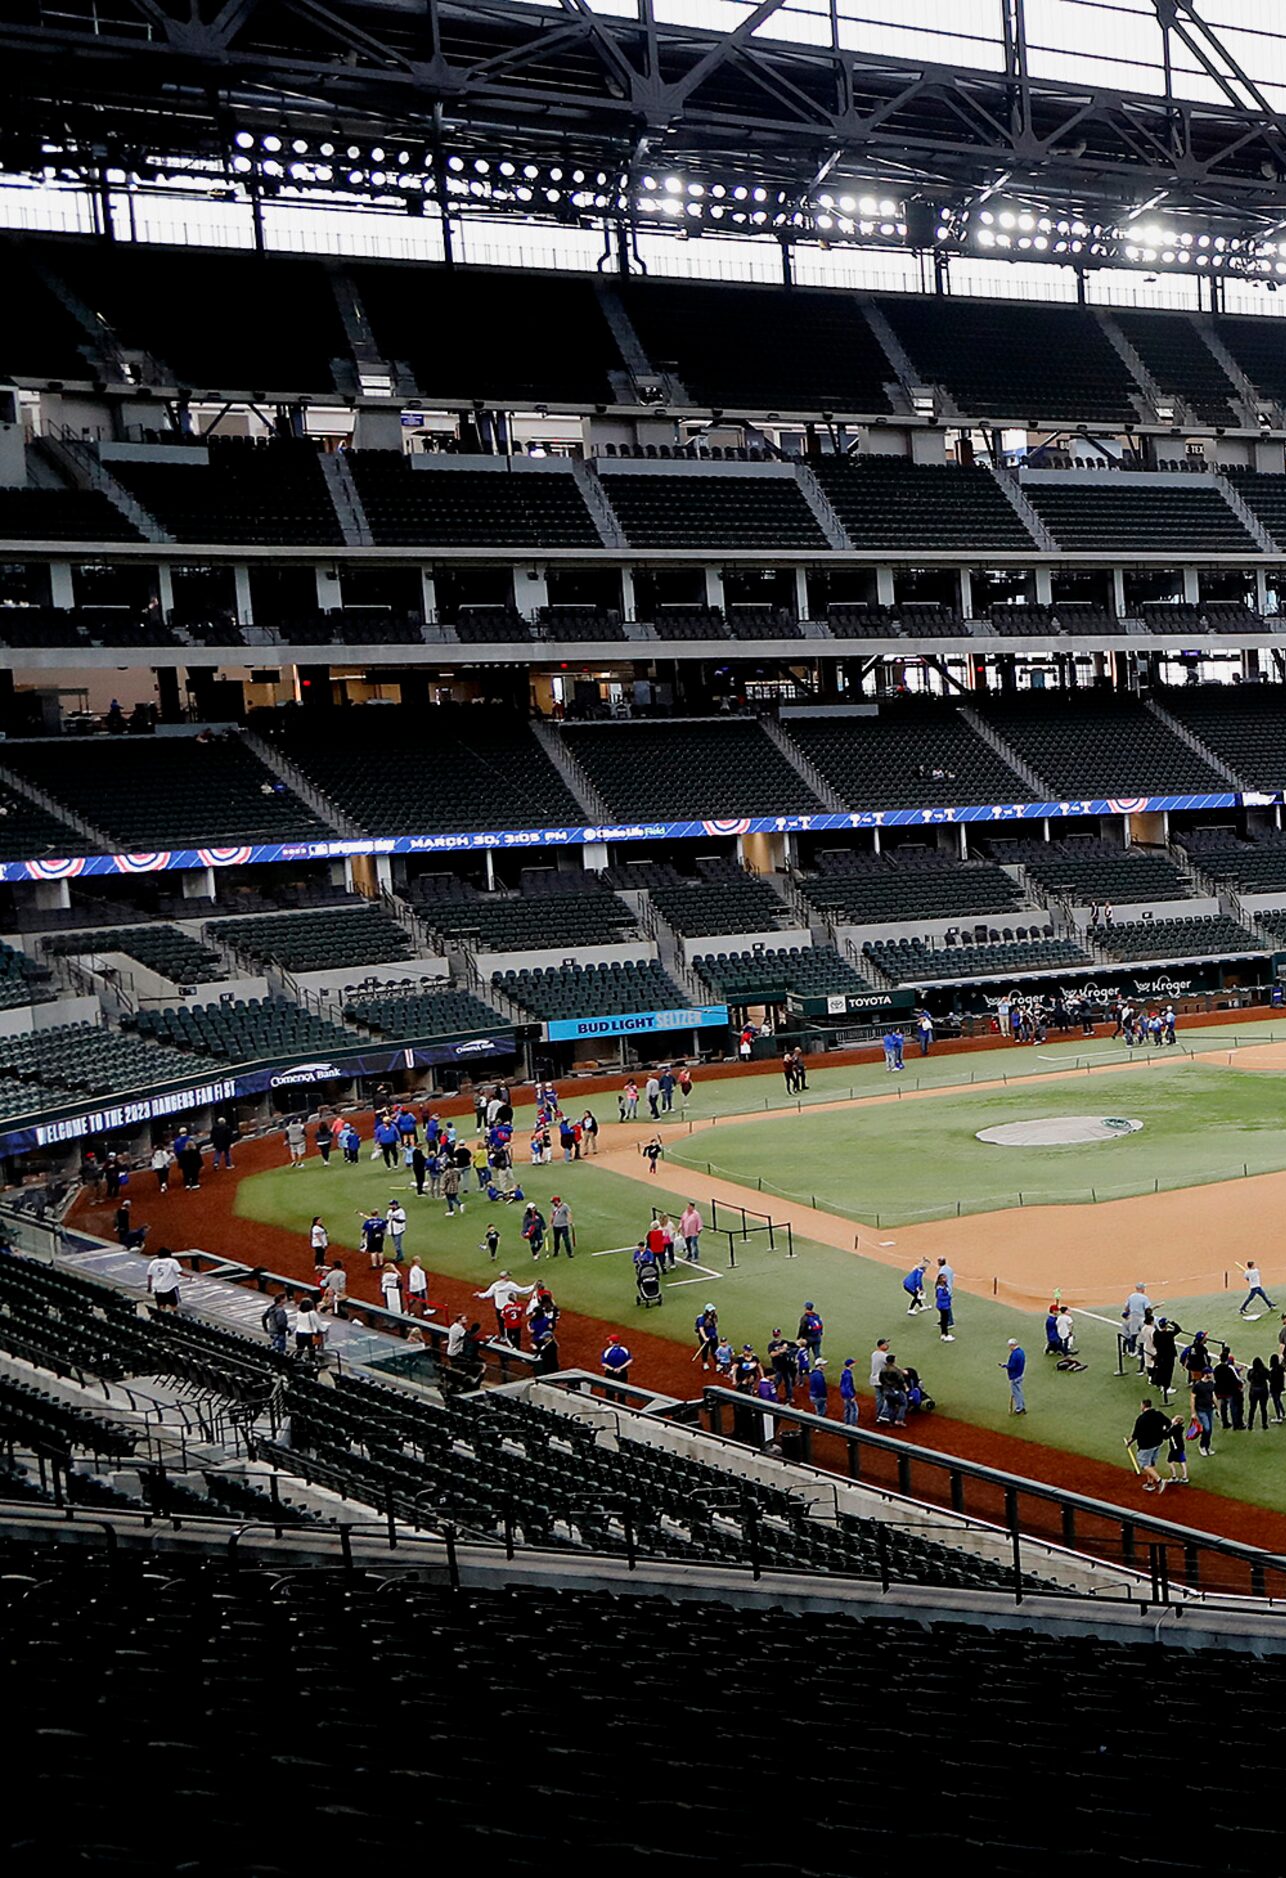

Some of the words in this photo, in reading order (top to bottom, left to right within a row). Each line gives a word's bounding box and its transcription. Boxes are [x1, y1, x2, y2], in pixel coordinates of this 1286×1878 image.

[410, 836, 466, 848] MARCH
[504, 833, 540, 844] 3:05
[545, 831, 567, 842] PM
[1152, 975, 1191, 997] Kroger
[849, 995, 892, 1007] TOYOTA
[578, 1020, 608, 1035] BUD
[610, 1016, 654, 1032] LIGHT
[655, 1009, 702, 1029] SELTZER
[316, 1068, 341, 1082] Bank
[36, 1118, 89, 1146] WELCOME
[89, 1112, 104, 1134] TO
[104, 1106, 125, 1129] THE
[125, 1101, 151, 1122] 2023
[151, 1090, 196, 1116] RANGERS
[196, 1084, 214, 1105] FAN
